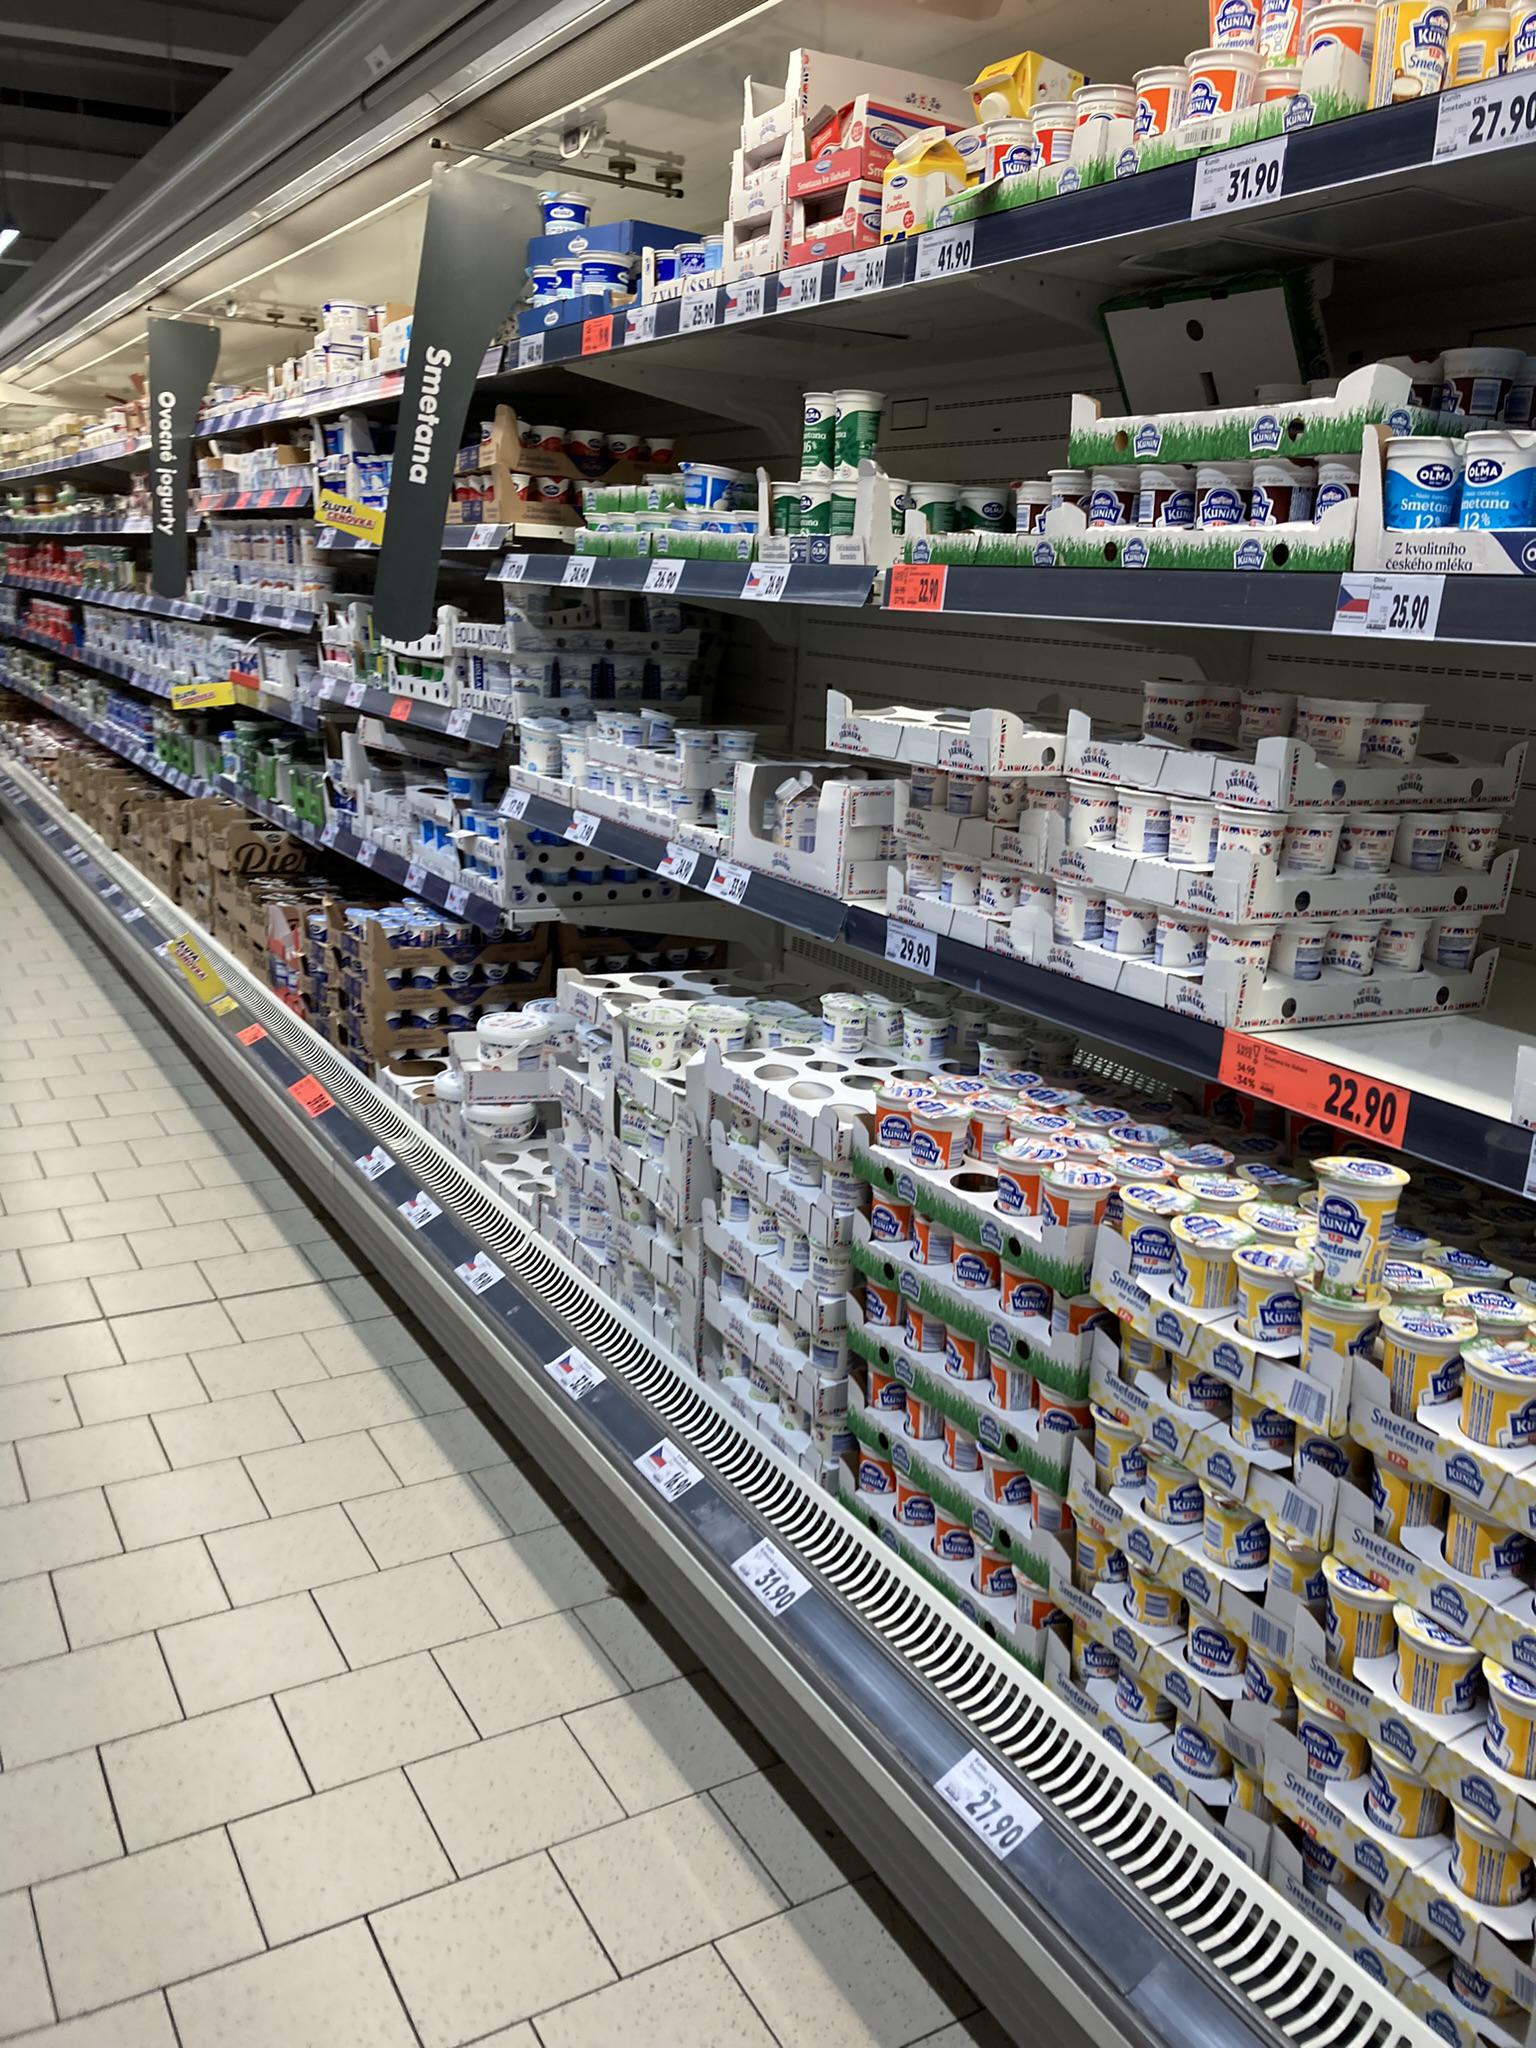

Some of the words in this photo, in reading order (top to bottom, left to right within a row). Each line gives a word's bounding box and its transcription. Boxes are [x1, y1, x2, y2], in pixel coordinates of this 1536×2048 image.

[1468, 91, 1536, 146] 27.90
[1227, 159, 1280, 203] 31.90
[938, 240, 970, 271] 41.90
[693, 303, 714, 325] 25.90
[157, 391, 177, 463] Ovocné
[409, 346, 452, 485] Smetana
[1420, 469, 1451, 482] OLMA
[1468, 464, 1499, 478] OLMA
[154, 467, 174, 537] jogurty
[1385, 557, 1433, 571] českého
[1435, 557, 1473, 572] mléka
[1395, 542, 1403, 555] Z
[1405, 542, 1466, 556] kvalitního
[654, 570, 677, 589] 26.90
[1389, 594, 1430, 630] 25.90
[900, 937, 931, 968] 29.90
[1323, 1073, 1397, 1135] 22.90
[1371, 1407, 1436, 1453] Smetana
[1351, 1527, 1416, 1576] Smetana
[754, 1567, 797, 1609] 31.90
[1058, 1579, 1102, 1620] Smetana
[1308, 1655, 1370, 1708] Smetana
[965, 1789, 1024, 1849] 27.90
[1284, 1773, 1343, 1829] Smetana
